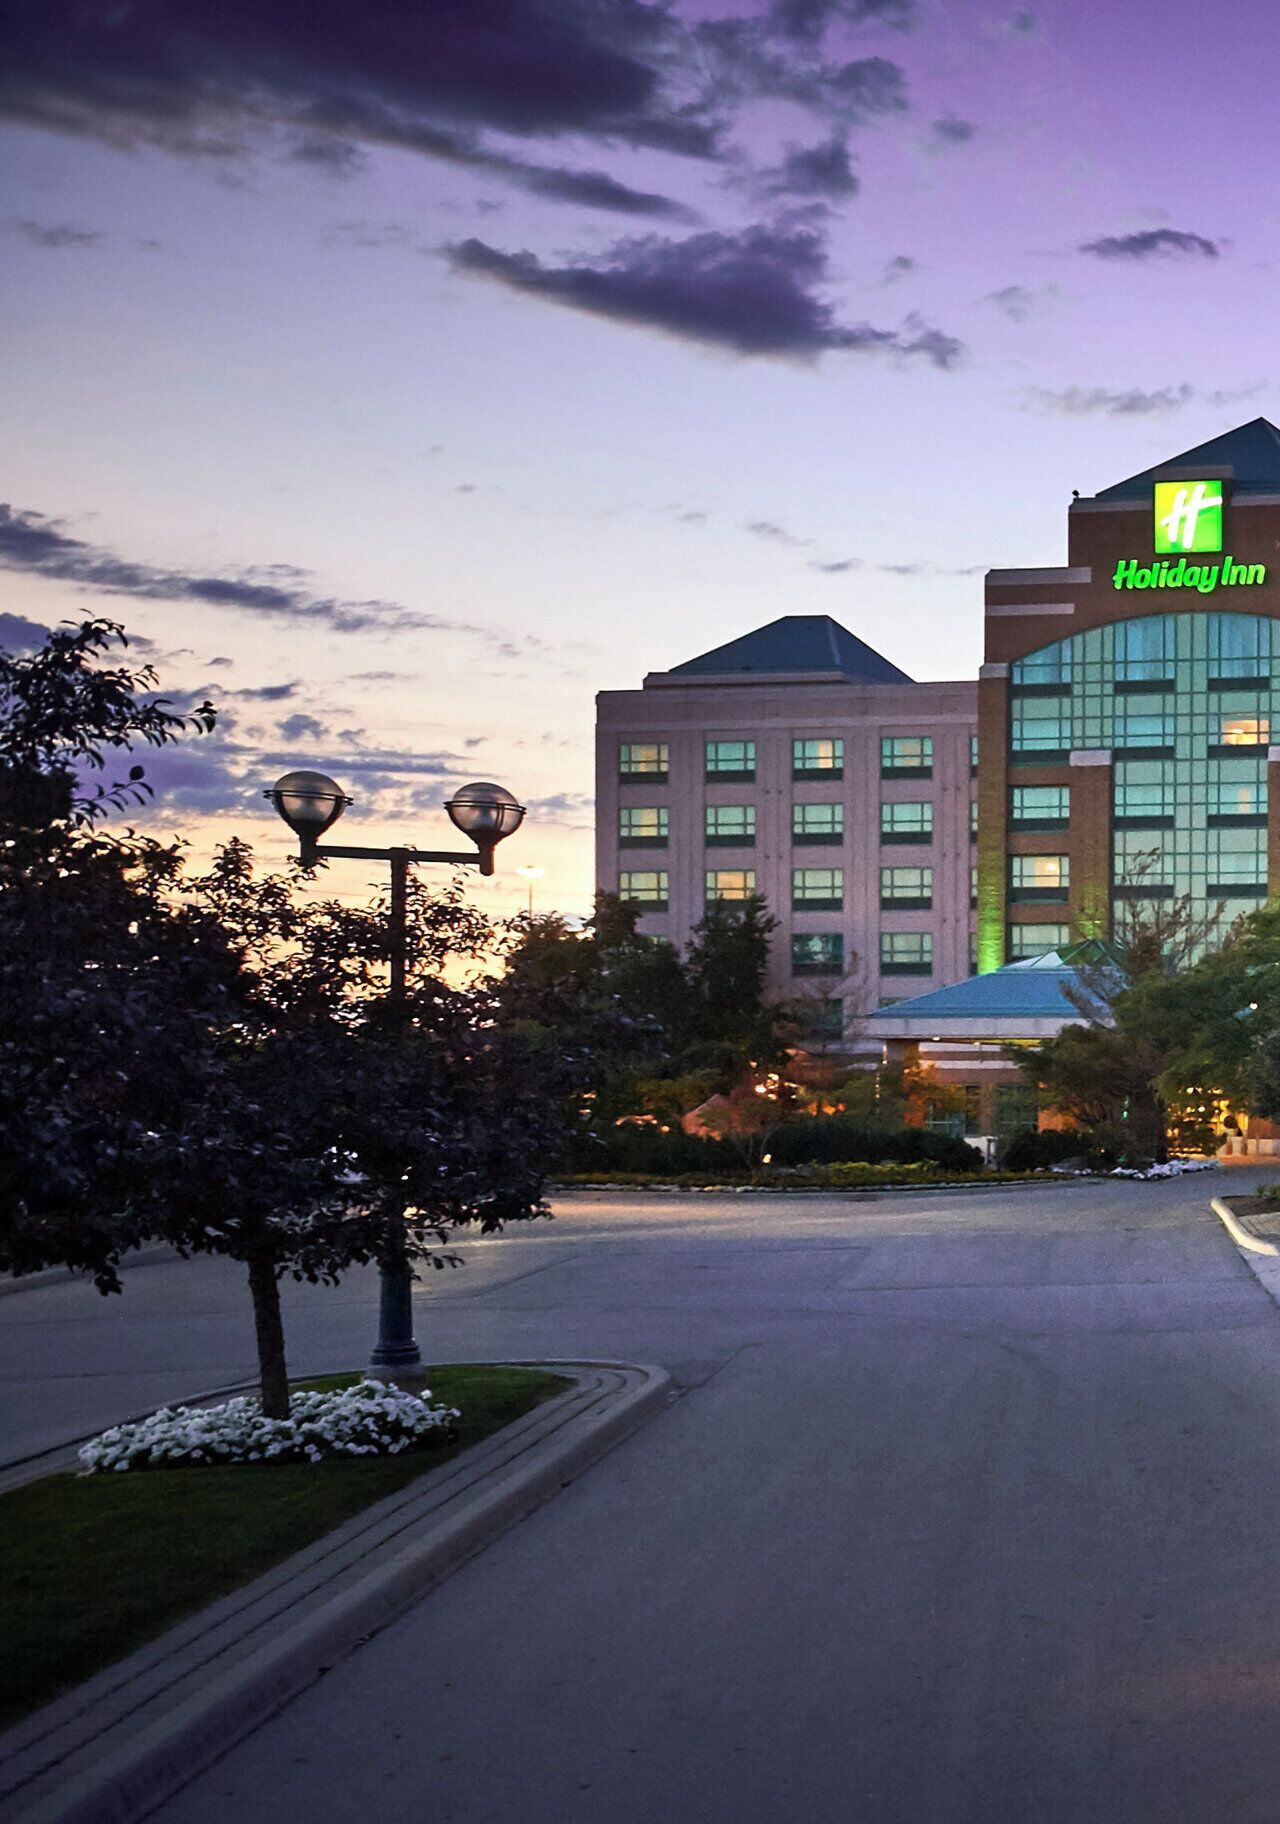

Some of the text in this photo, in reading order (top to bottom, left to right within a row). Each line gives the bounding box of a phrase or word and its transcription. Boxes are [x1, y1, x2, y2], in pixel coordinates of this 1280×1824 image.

[1160, 484, 1223, 549] H
[1112, 556, 1266, 592] Holiday Inn
